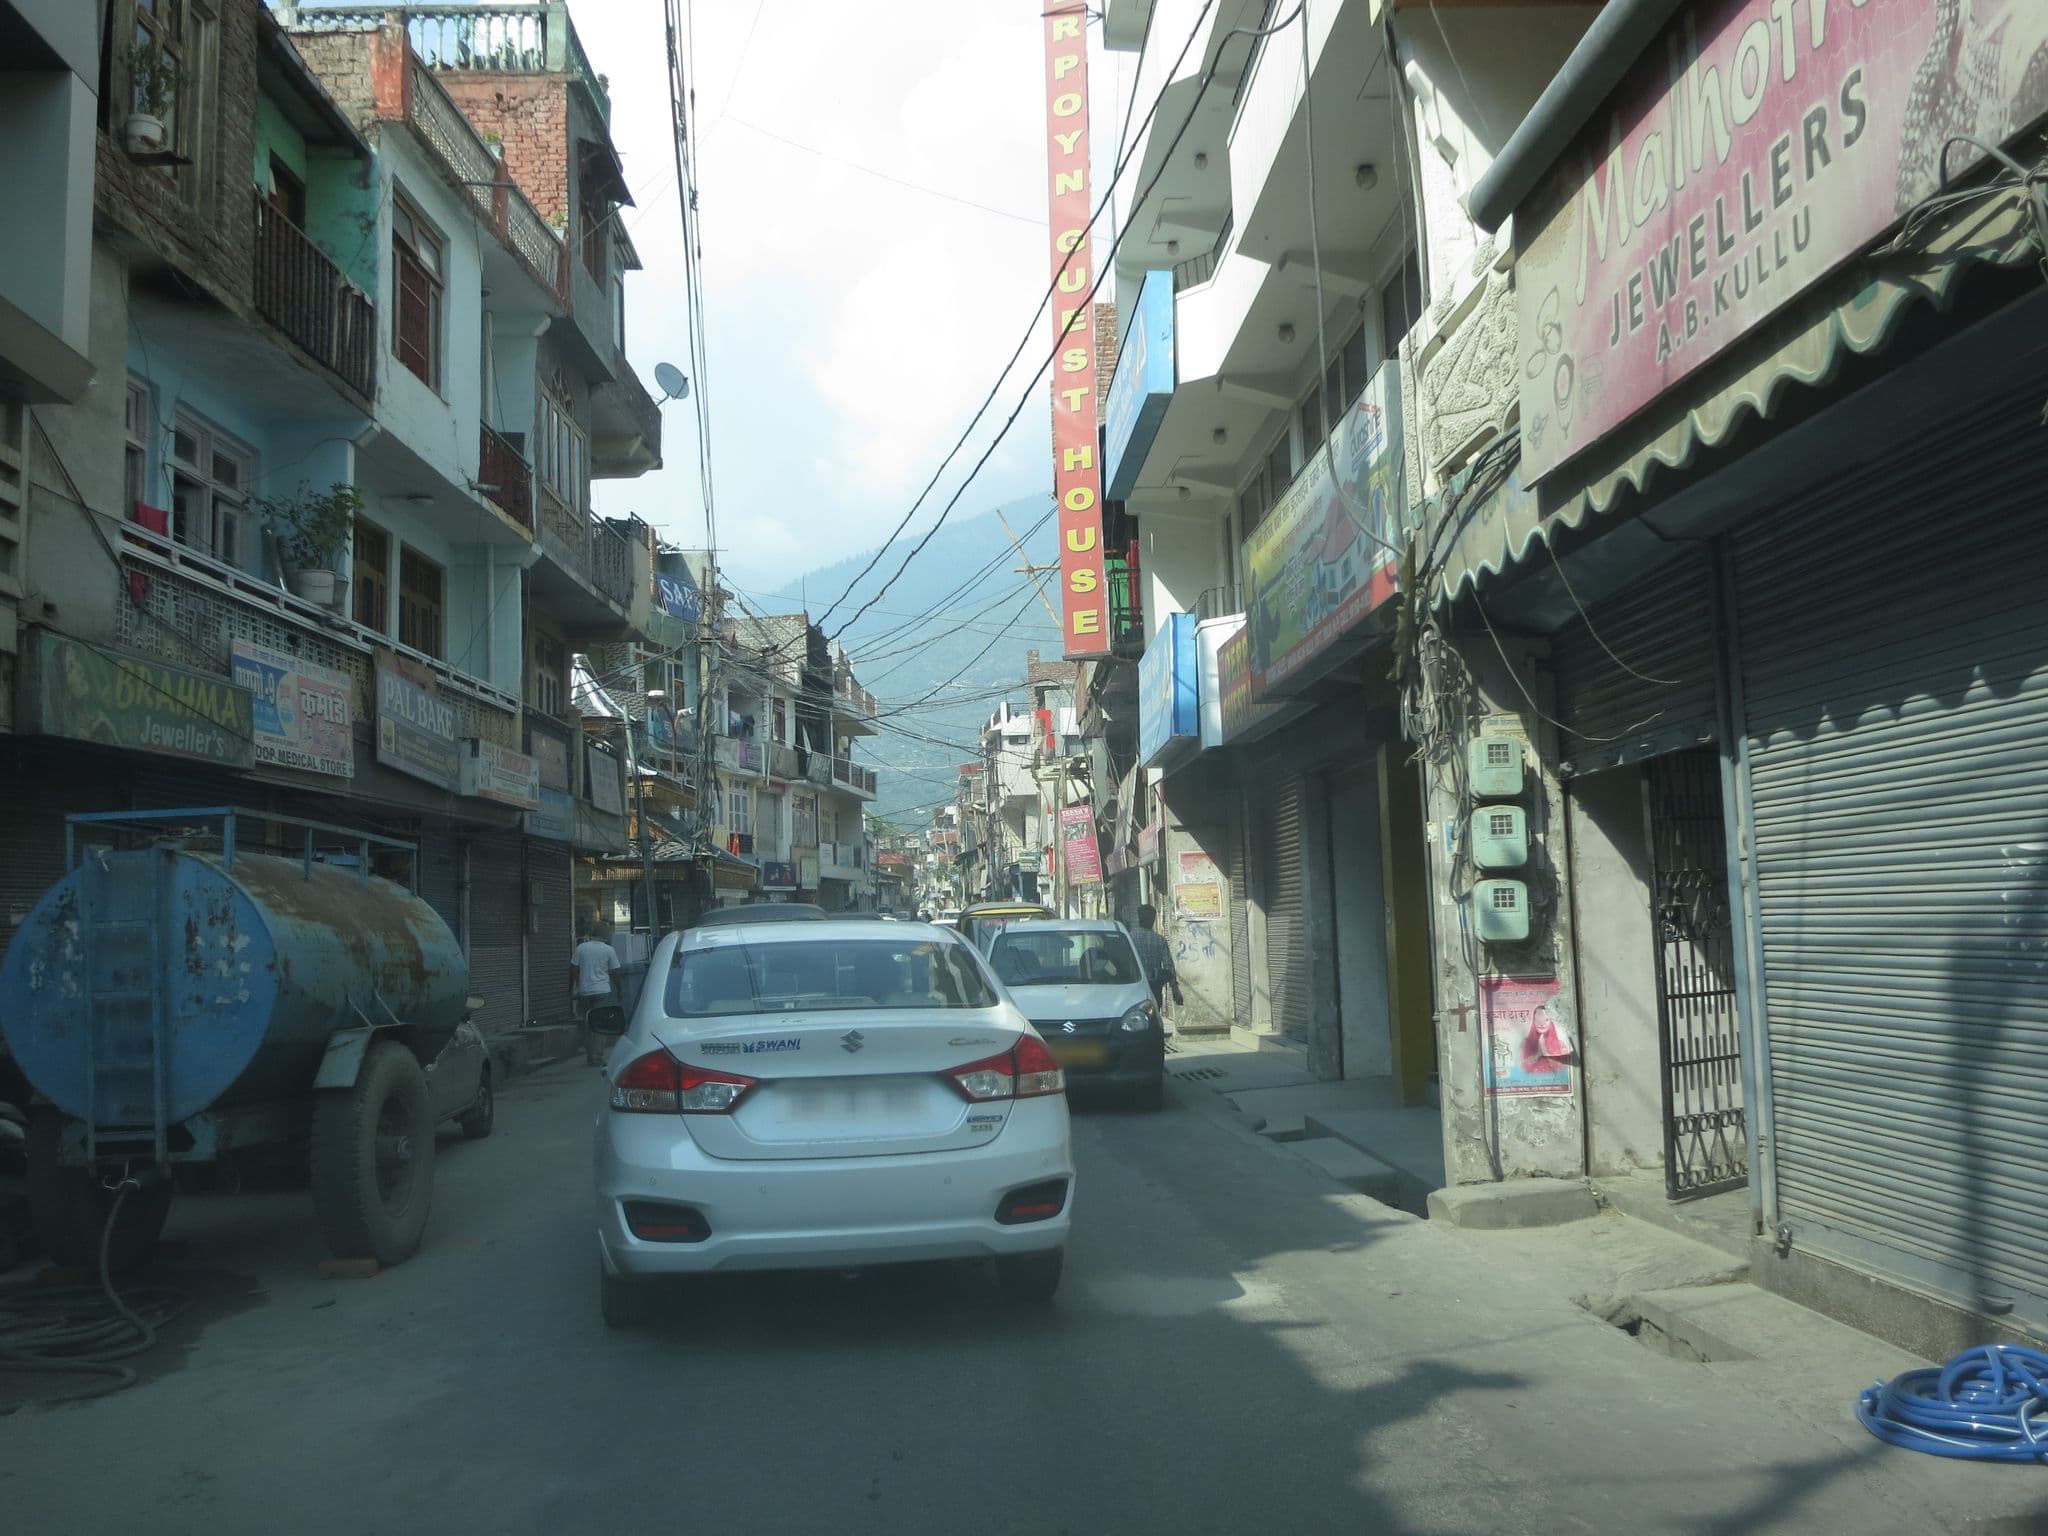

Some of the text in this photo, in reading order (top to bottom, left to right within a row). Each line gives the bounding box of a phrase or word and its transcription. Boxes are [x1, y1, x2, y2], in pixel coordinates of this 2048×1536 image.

[1608, 67, 1869, 347] JEWELLERS
[1055, 229, 1090, 413] GUEST
[1063, 446, 1100, 637] HOUSE
[116, 659, 239, 728] BRAHMA
[383, 674, 416, 720] PAL
[140, 715, 225, 757] Jeweller's
[279, 747, 318, 770] MEDICAL
[320, 758, 348, 776] STORE
